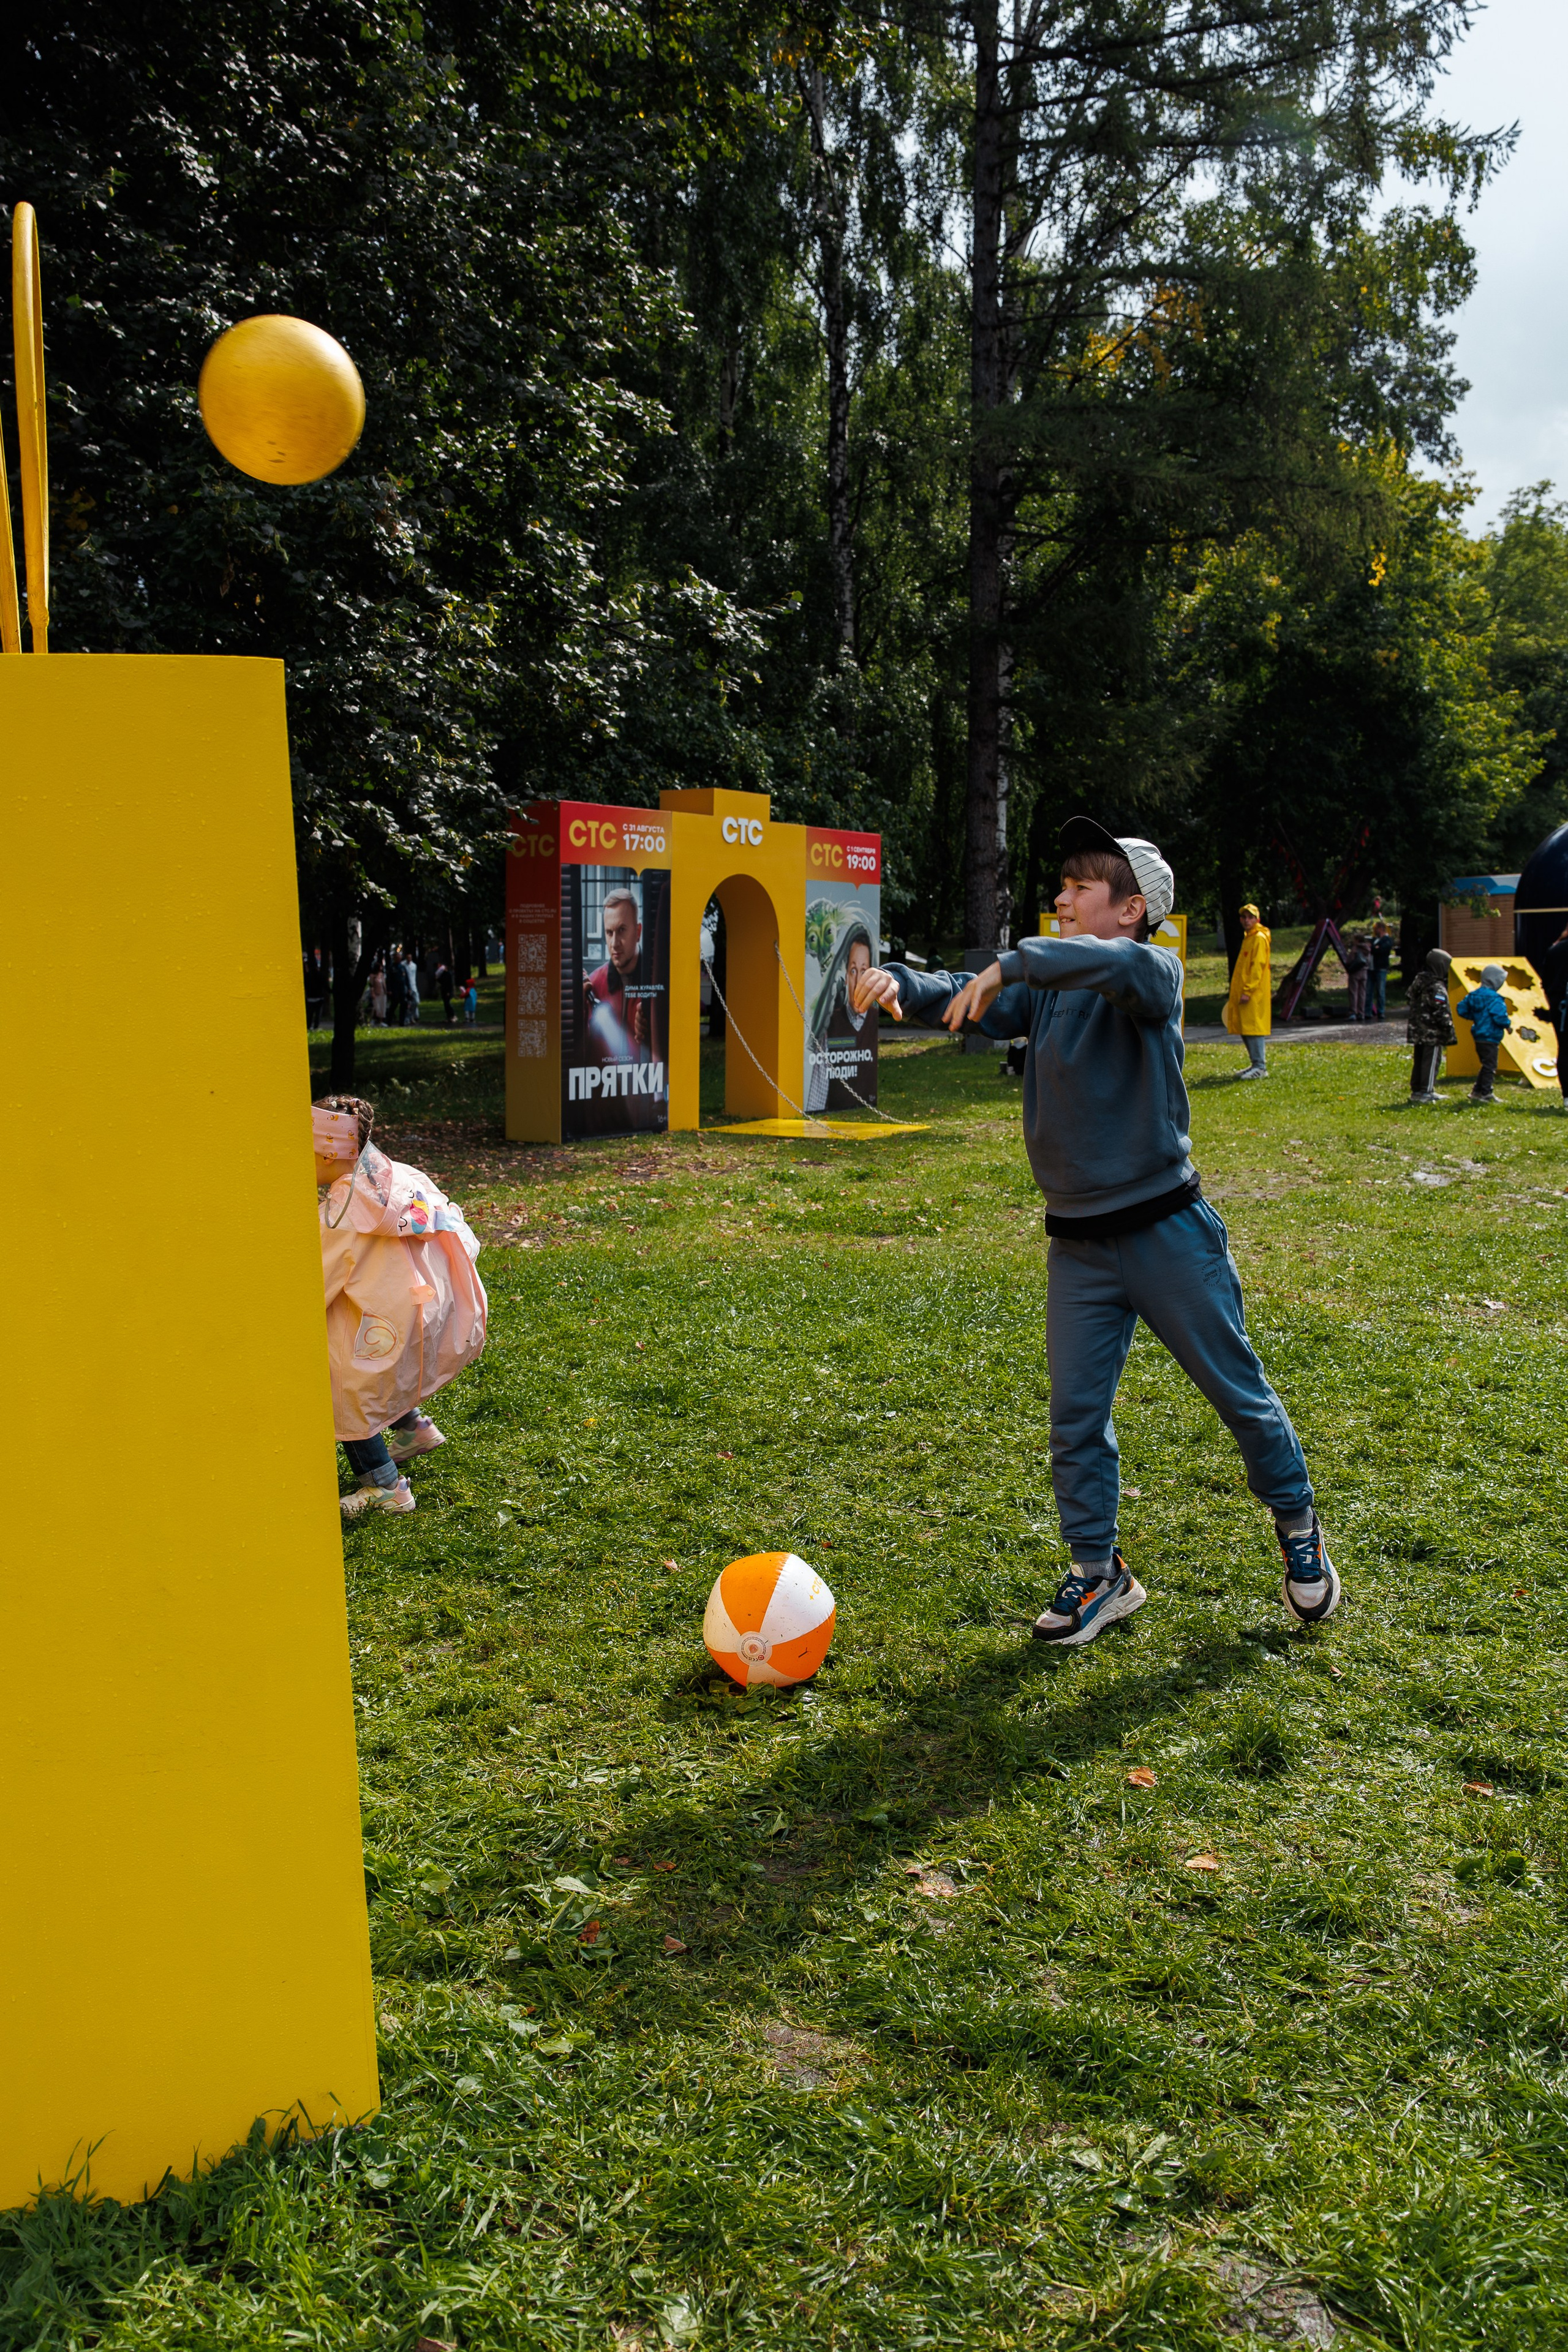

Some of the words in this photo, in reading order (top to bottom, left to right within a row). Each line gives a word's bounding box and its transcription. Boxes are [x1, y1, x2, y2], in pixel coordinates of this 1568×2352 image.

[569, 820, 617, 849] СТС
[636, 824, 665, 834] АВГУСТА
[722, 816, 763, 846] СТС
[511, 834, 555, 858] СТС
[623, 834, 665, 853] 17:00
[810, 843, 843, 868] СТС
[846, 854, 876, 871] 19:00
[809, 1049, 873, 1066] ОСТОРОЖНО,
[568, 1062, 664, 1101] ПРЯТКИ
[826, 1065, 858, 1080] ЛЮДИ!
